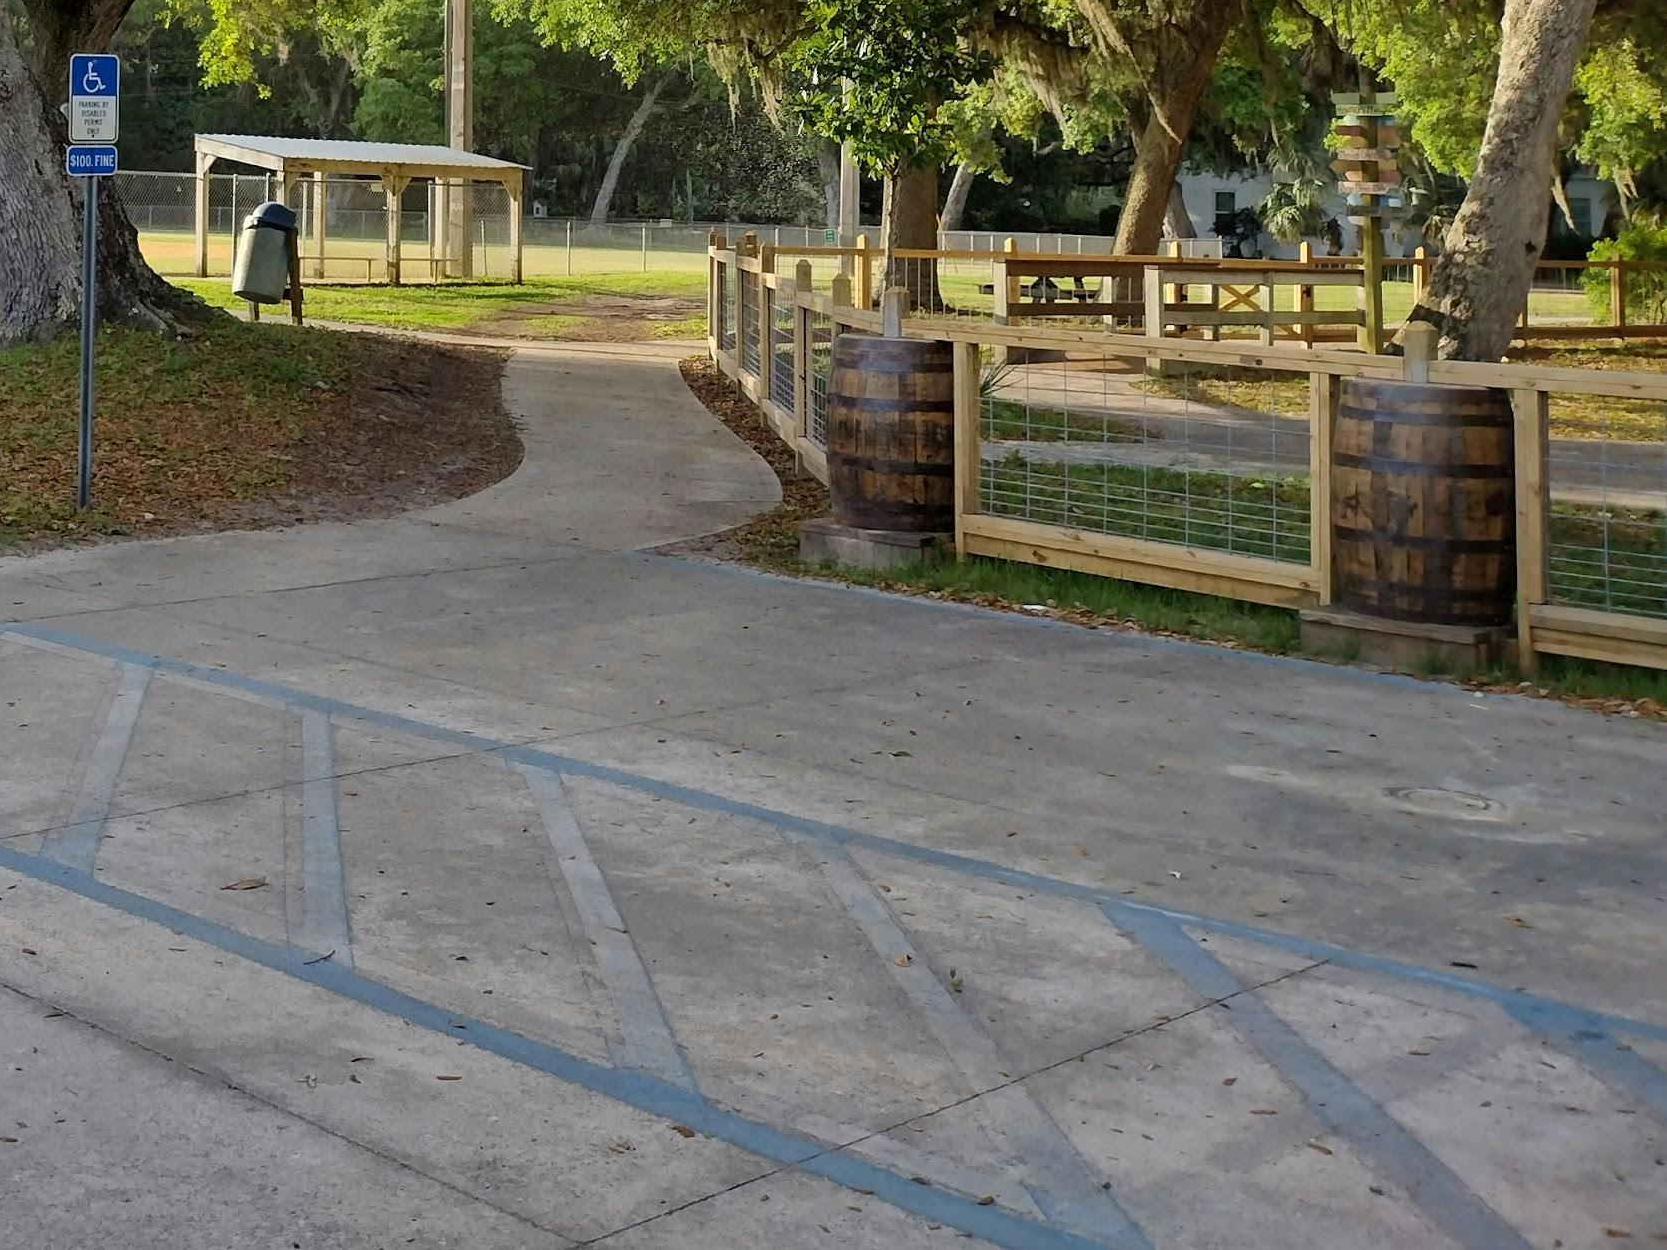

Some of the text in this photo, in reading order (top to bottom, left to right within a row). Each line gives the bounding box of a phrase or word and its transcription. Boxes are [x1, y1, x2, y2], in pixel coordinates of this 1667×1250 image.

[102, 101, 110, 109] BY
[86, 127, 100, 135] ONLY
[95, 154, 115, 167] FINE
